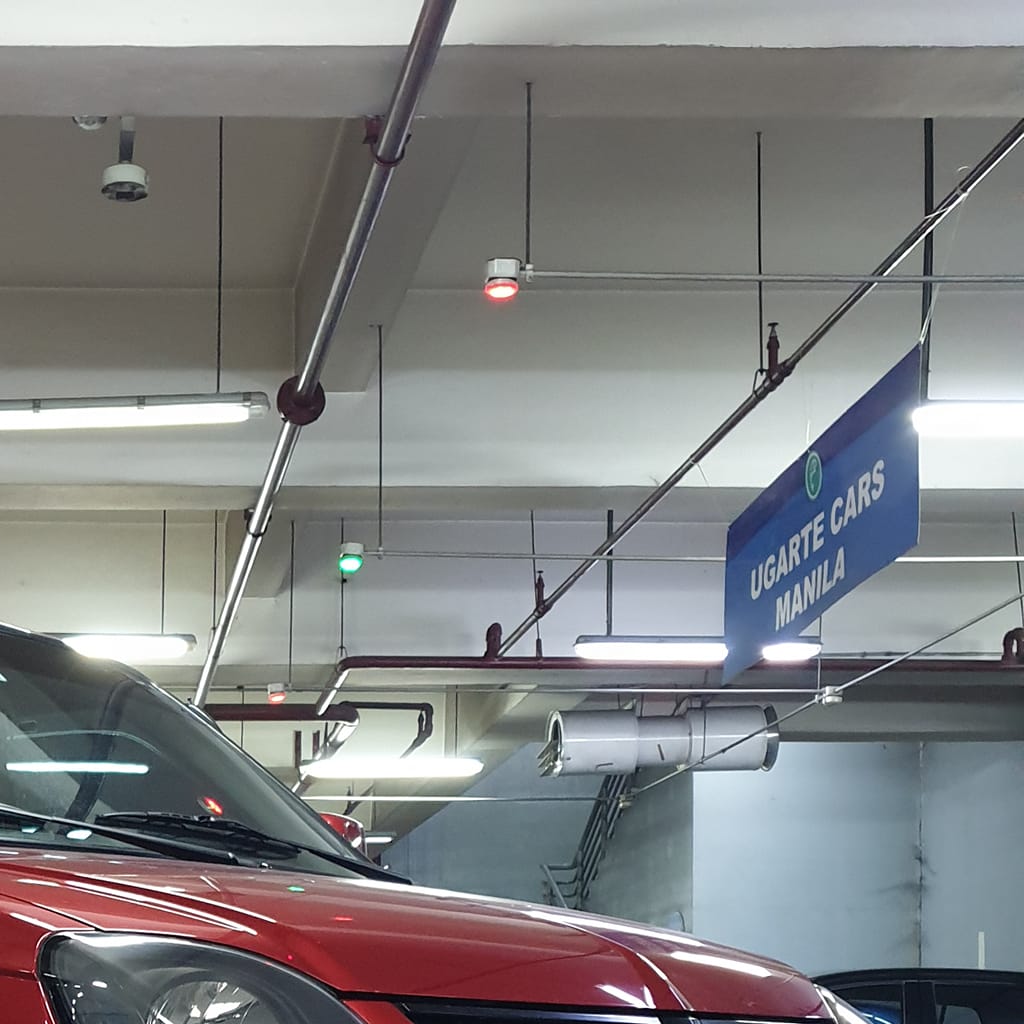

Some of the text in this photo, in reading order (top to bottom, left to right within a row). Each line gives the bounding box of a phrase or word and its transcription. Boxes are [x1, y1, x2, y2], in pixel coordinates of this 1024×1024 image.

[750, 459, 885, 600] UGARTE CARS
[775, 546, 846, 631] MANILA
